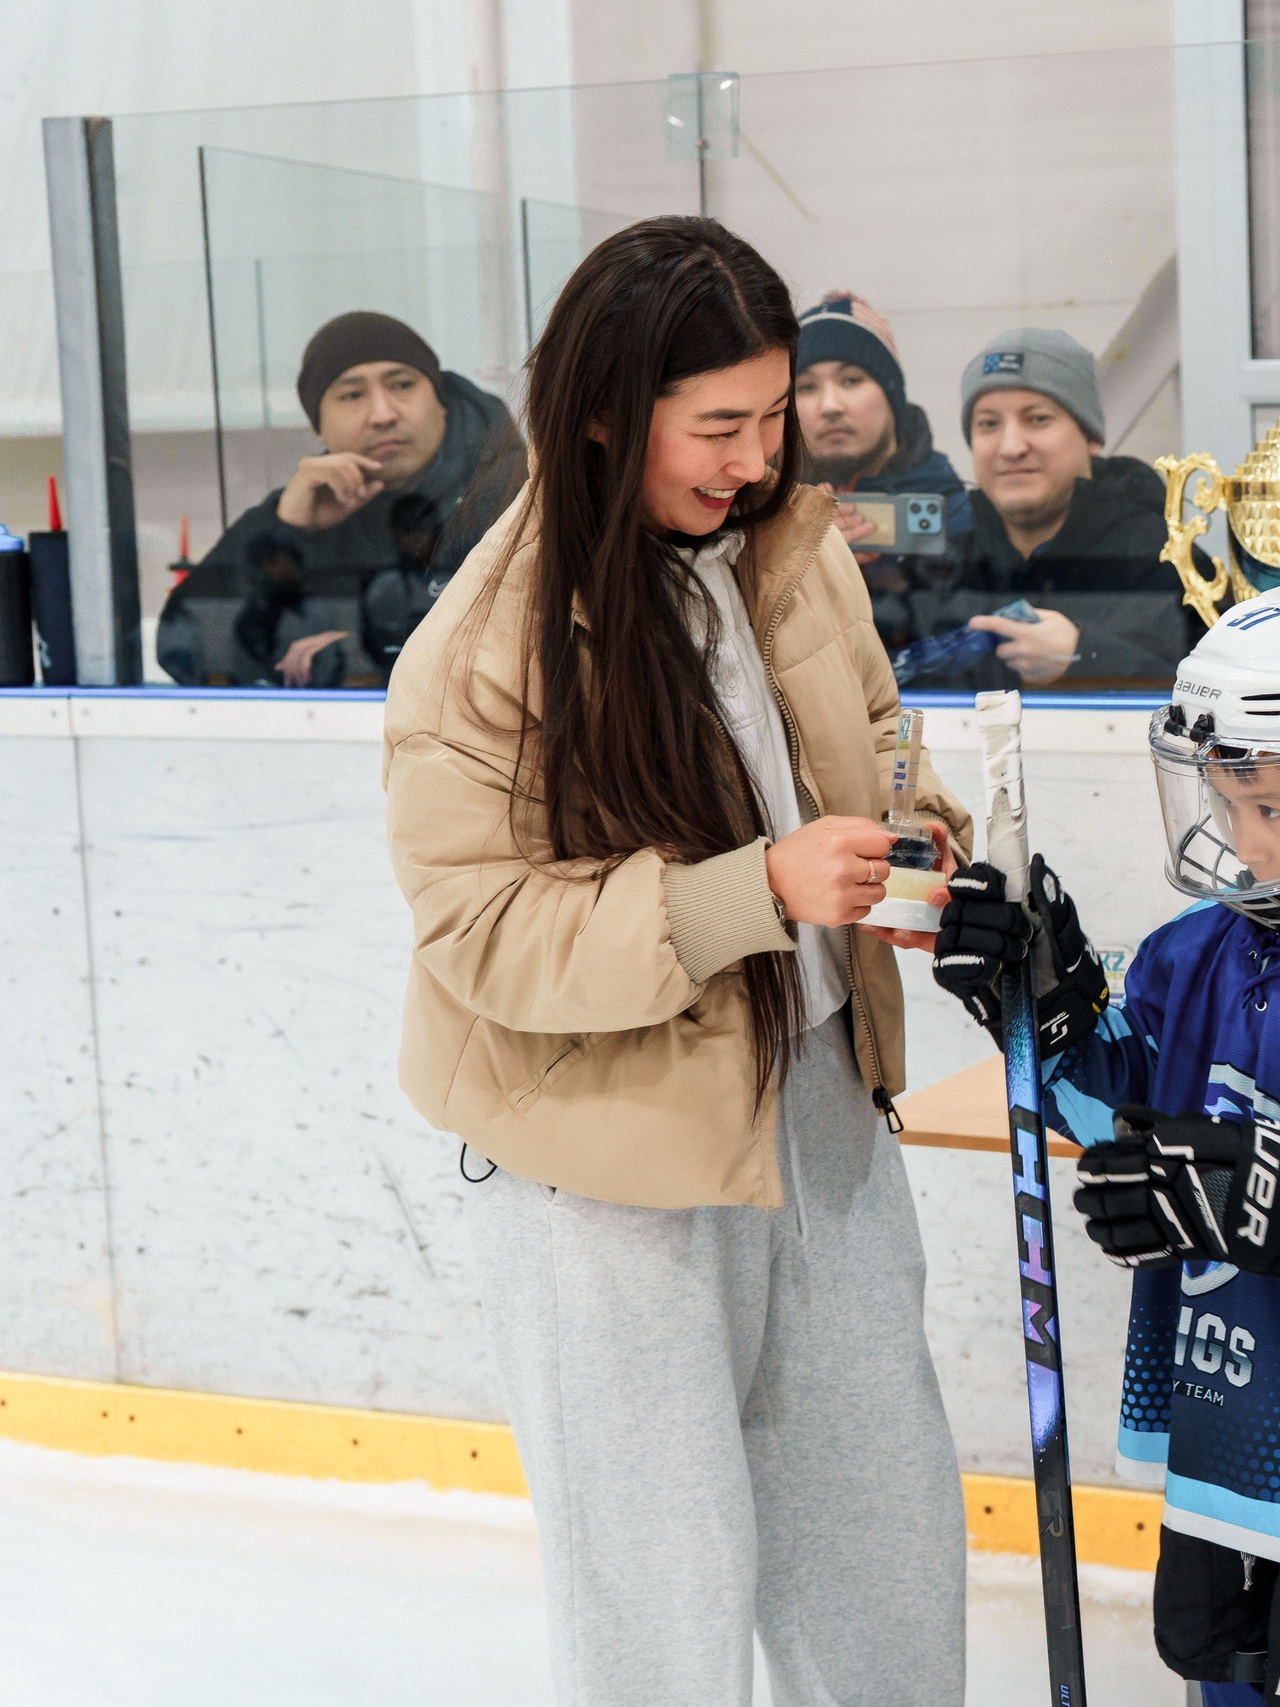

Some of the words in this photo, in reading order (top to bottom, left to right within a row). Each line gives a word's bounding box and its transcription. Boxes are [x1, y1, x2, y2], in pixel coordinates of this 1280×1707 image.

[1176, 680, 1222, 700] BAUER
[1099, 953, 1125, 971] KZ
[1009, 1104, 1059, 1373] CCM
[1185, 1383, 1224, 1407] TEAM
